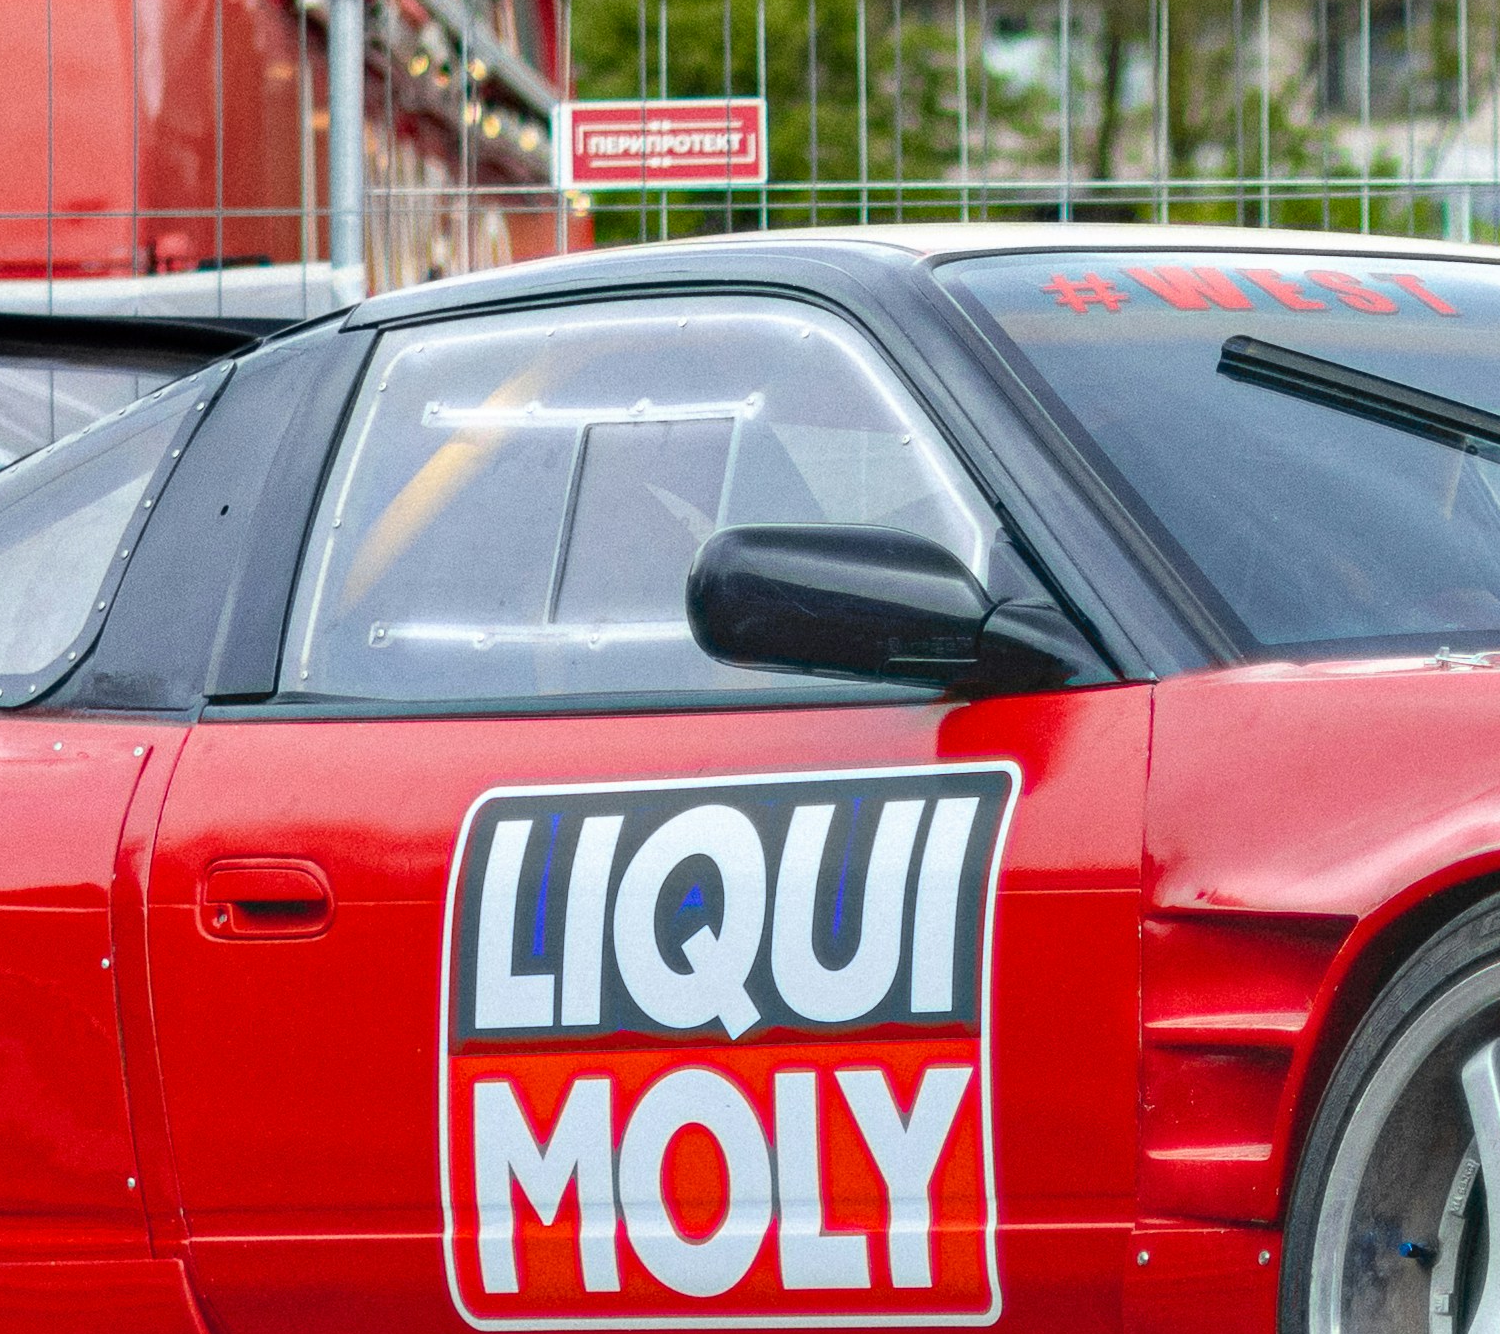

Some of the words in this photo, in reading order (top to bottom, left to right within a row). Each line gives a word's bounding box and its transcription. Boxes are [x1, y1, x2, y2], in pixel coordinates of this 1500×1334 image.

[588, 133, 743, 155] ПЕРИПРОТЕКТ
[474, 797, 980, 1041] LIQUI
[473, 1067, 974, 1298] MOLY
